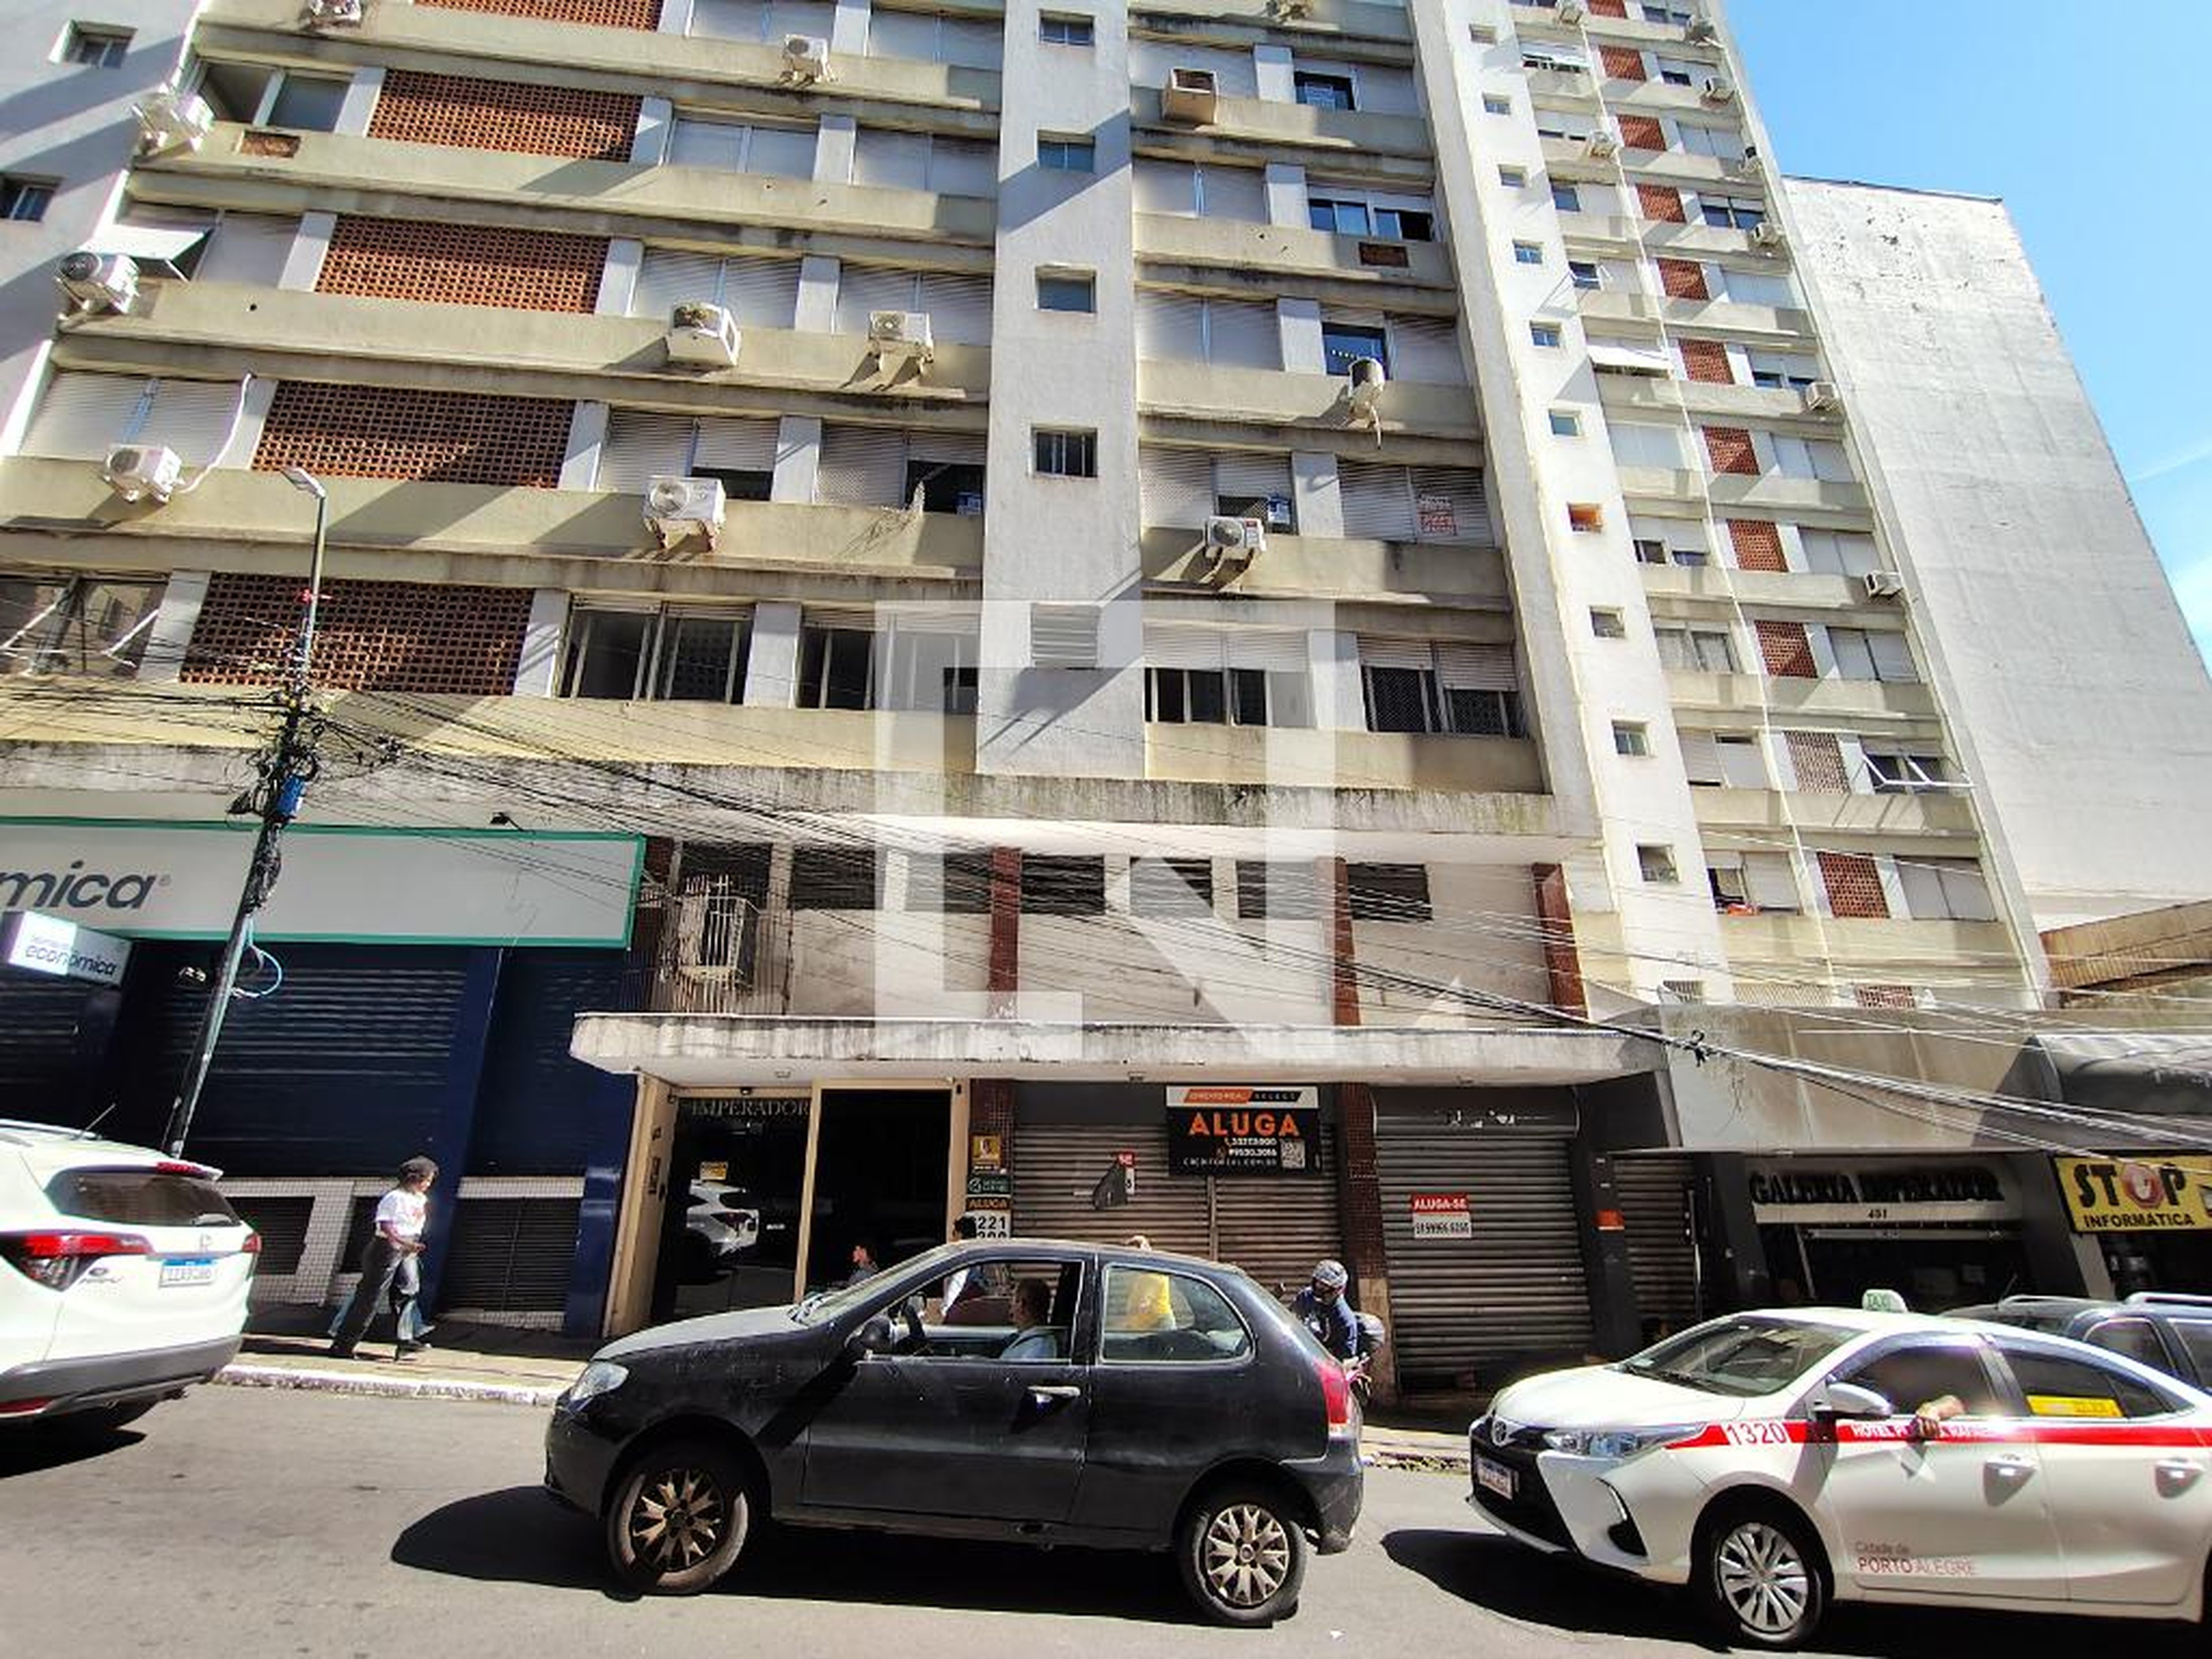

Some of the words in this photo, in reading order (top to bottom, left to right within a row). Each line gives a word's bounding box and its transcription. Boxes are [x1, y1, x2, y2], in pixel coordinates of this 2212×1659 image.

[692, 1098, 808, 1116] IMPERADOR
[1188, 1111, 1300, 1136] ALUGA
[2074, 1162, 2186, 1207] STOP
[969, 1199, 1008, 1208] ALUGA
[1414, 1198, 1467, 1210] ALUGA-SE
[974, 1215, 1006, 1230] 221
[1728, 1421, 1787, 1445] 1320
[1857, 1556, 1912, 1574] PORTO
